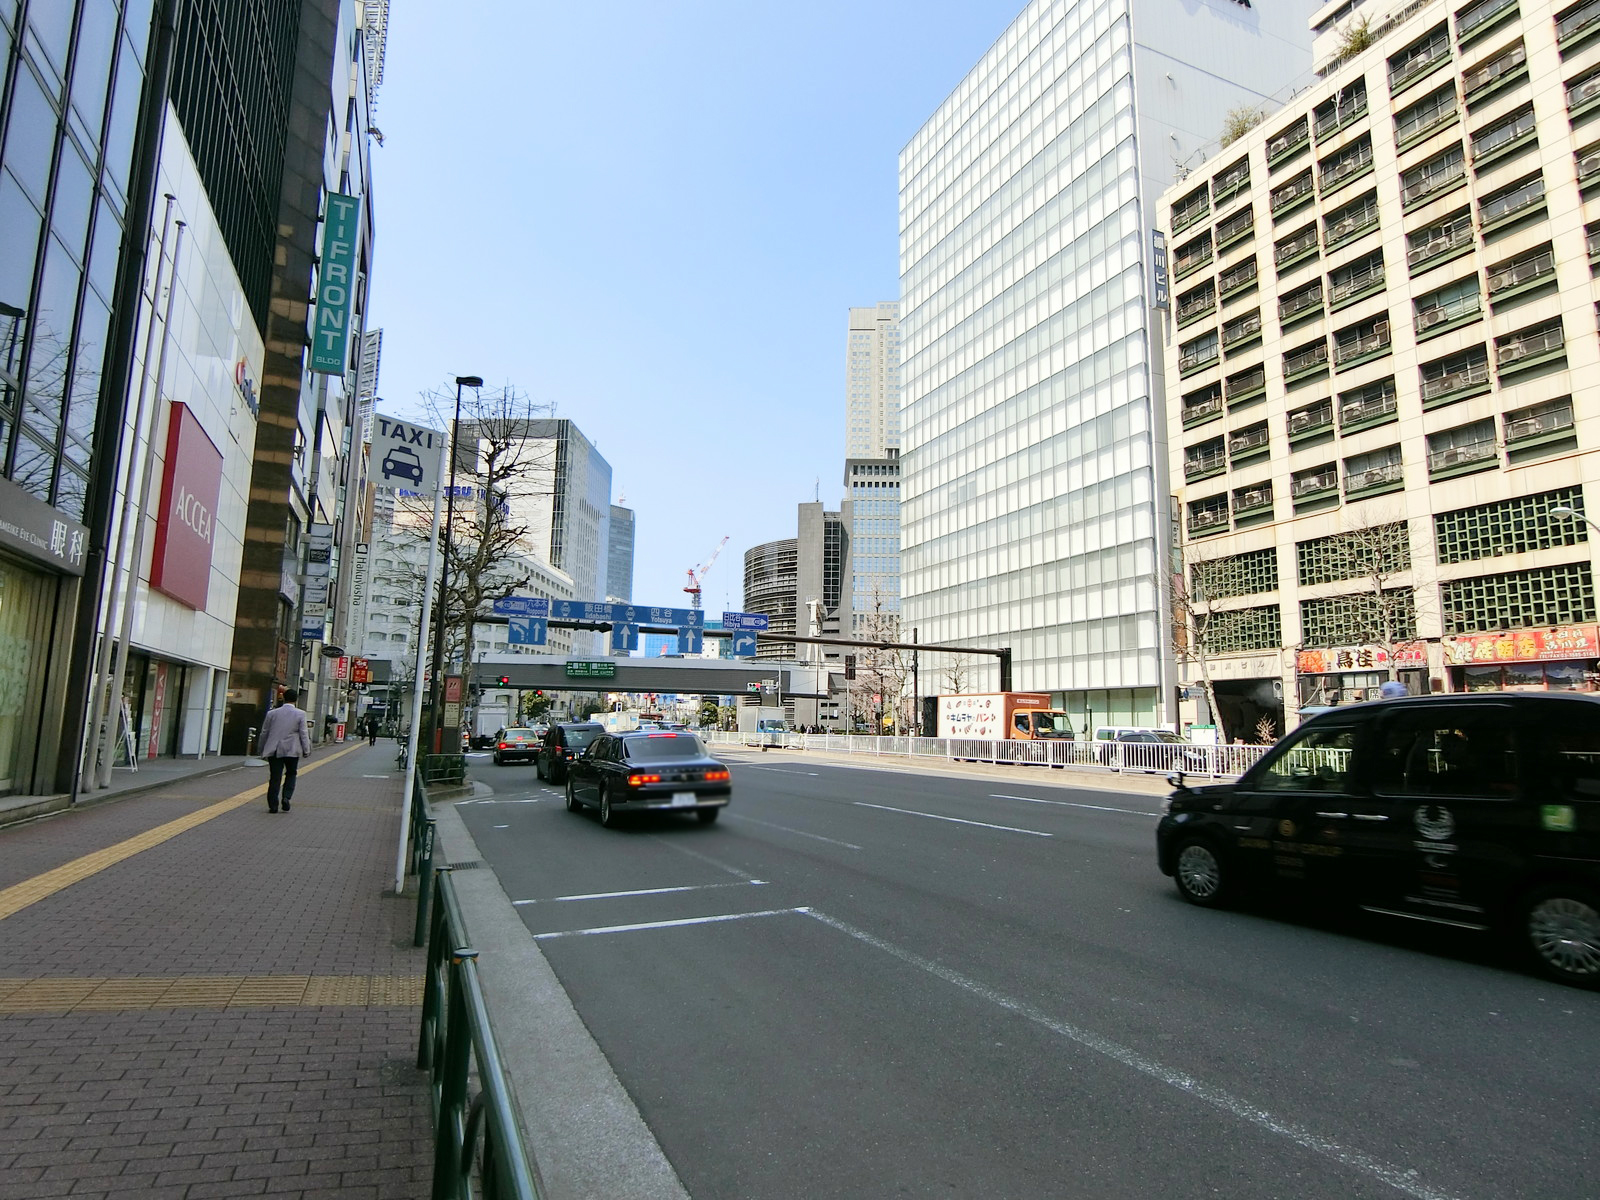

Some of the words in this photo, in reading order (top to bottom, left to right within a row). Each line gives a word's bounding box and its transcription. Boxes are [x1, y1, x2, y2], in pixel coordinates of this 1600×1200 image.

[321, 200, 353, 351] TIFRONT
[316, 356, 341, 365] BLDG
[379, 419, 433, 449] TAXI
[176, 486, 211, 544] ACCEA
[51, 520, 84, 566] 眼科
[353, 557, 367, 606] Hakuyosha
[527, 599, 548, 608] 六本木
[584, 603, 612, 614] 飯田橋
[527, 607, 547, 616] Roppongi
[651, 608, 672, 618] 四谷
[651, 616, 672, 625] Yotsuya
[724, 613, 741, 622] 日比谷
